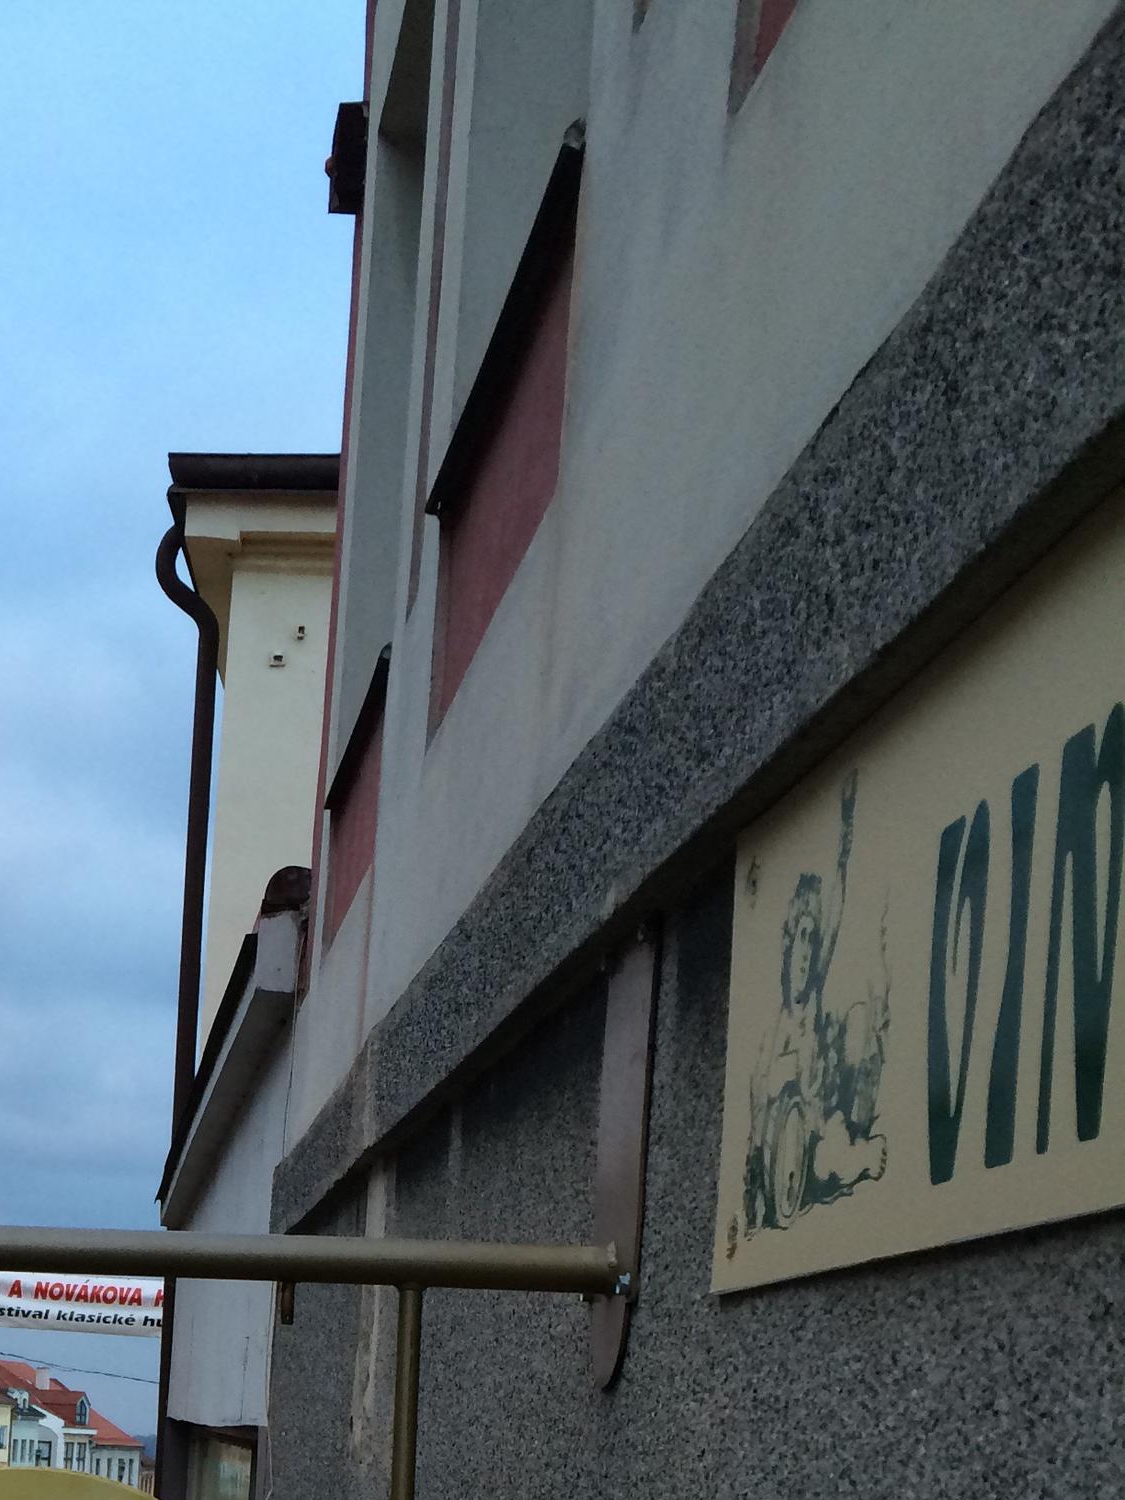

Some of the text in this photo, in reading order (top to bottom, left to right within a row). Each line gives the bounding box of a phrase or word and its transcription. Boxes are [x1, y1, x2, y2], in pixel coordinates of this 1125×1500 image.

[8, 1279, 22, 1299] A
[34, 1279, 142, 1307] NOVÁKOVA
[56, 1310, 136, 1327] klasické
